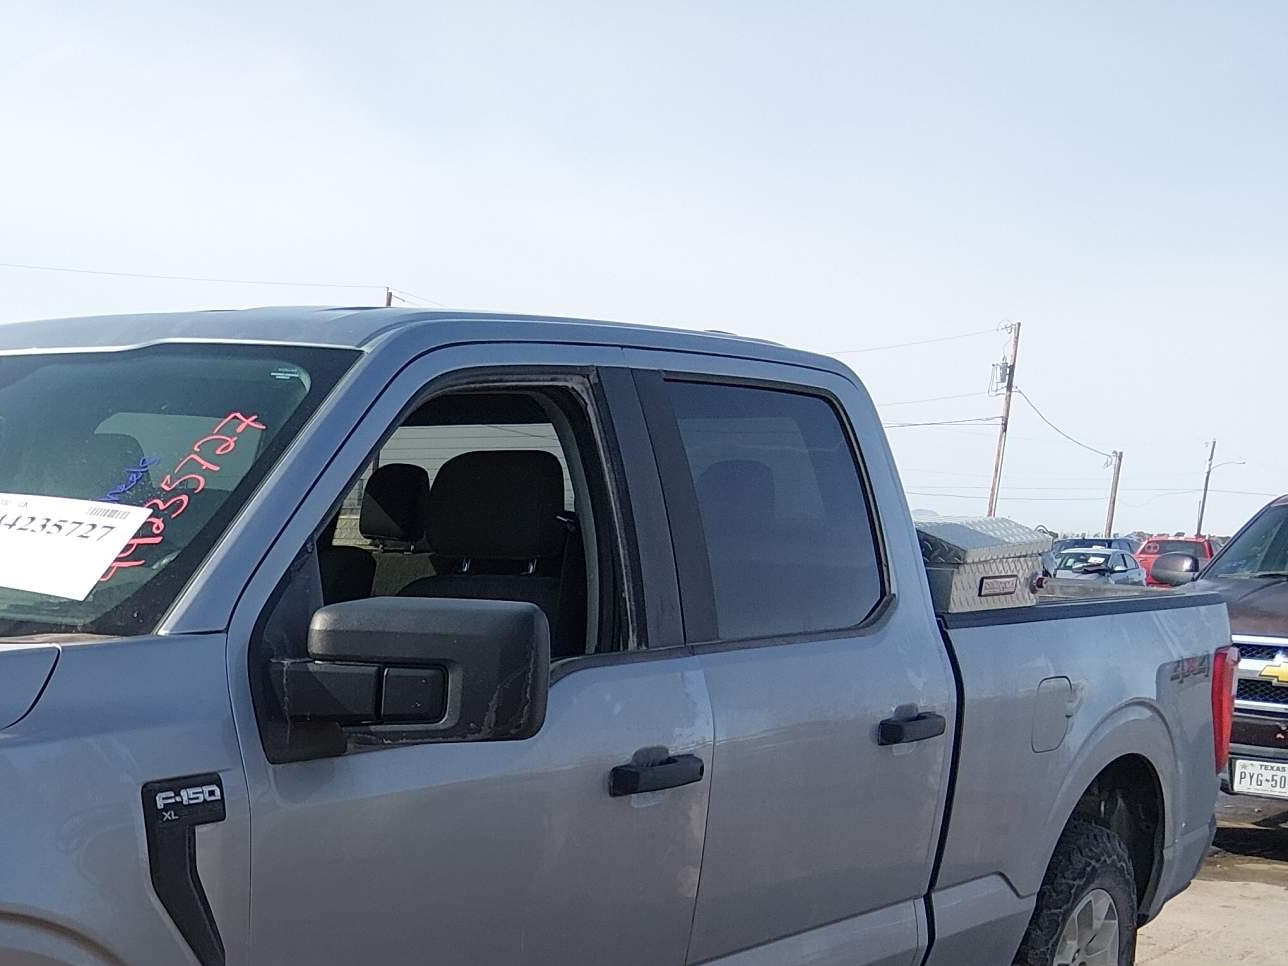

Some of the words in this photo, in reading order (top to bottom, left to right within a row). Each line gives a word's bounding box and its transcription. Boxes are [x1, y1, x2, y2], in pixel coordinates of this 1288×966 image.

[1259, 764, 1287, 772] TEXAS
[156, 784, 221, 809] F-150
[162, 810, 179, 821] XL
